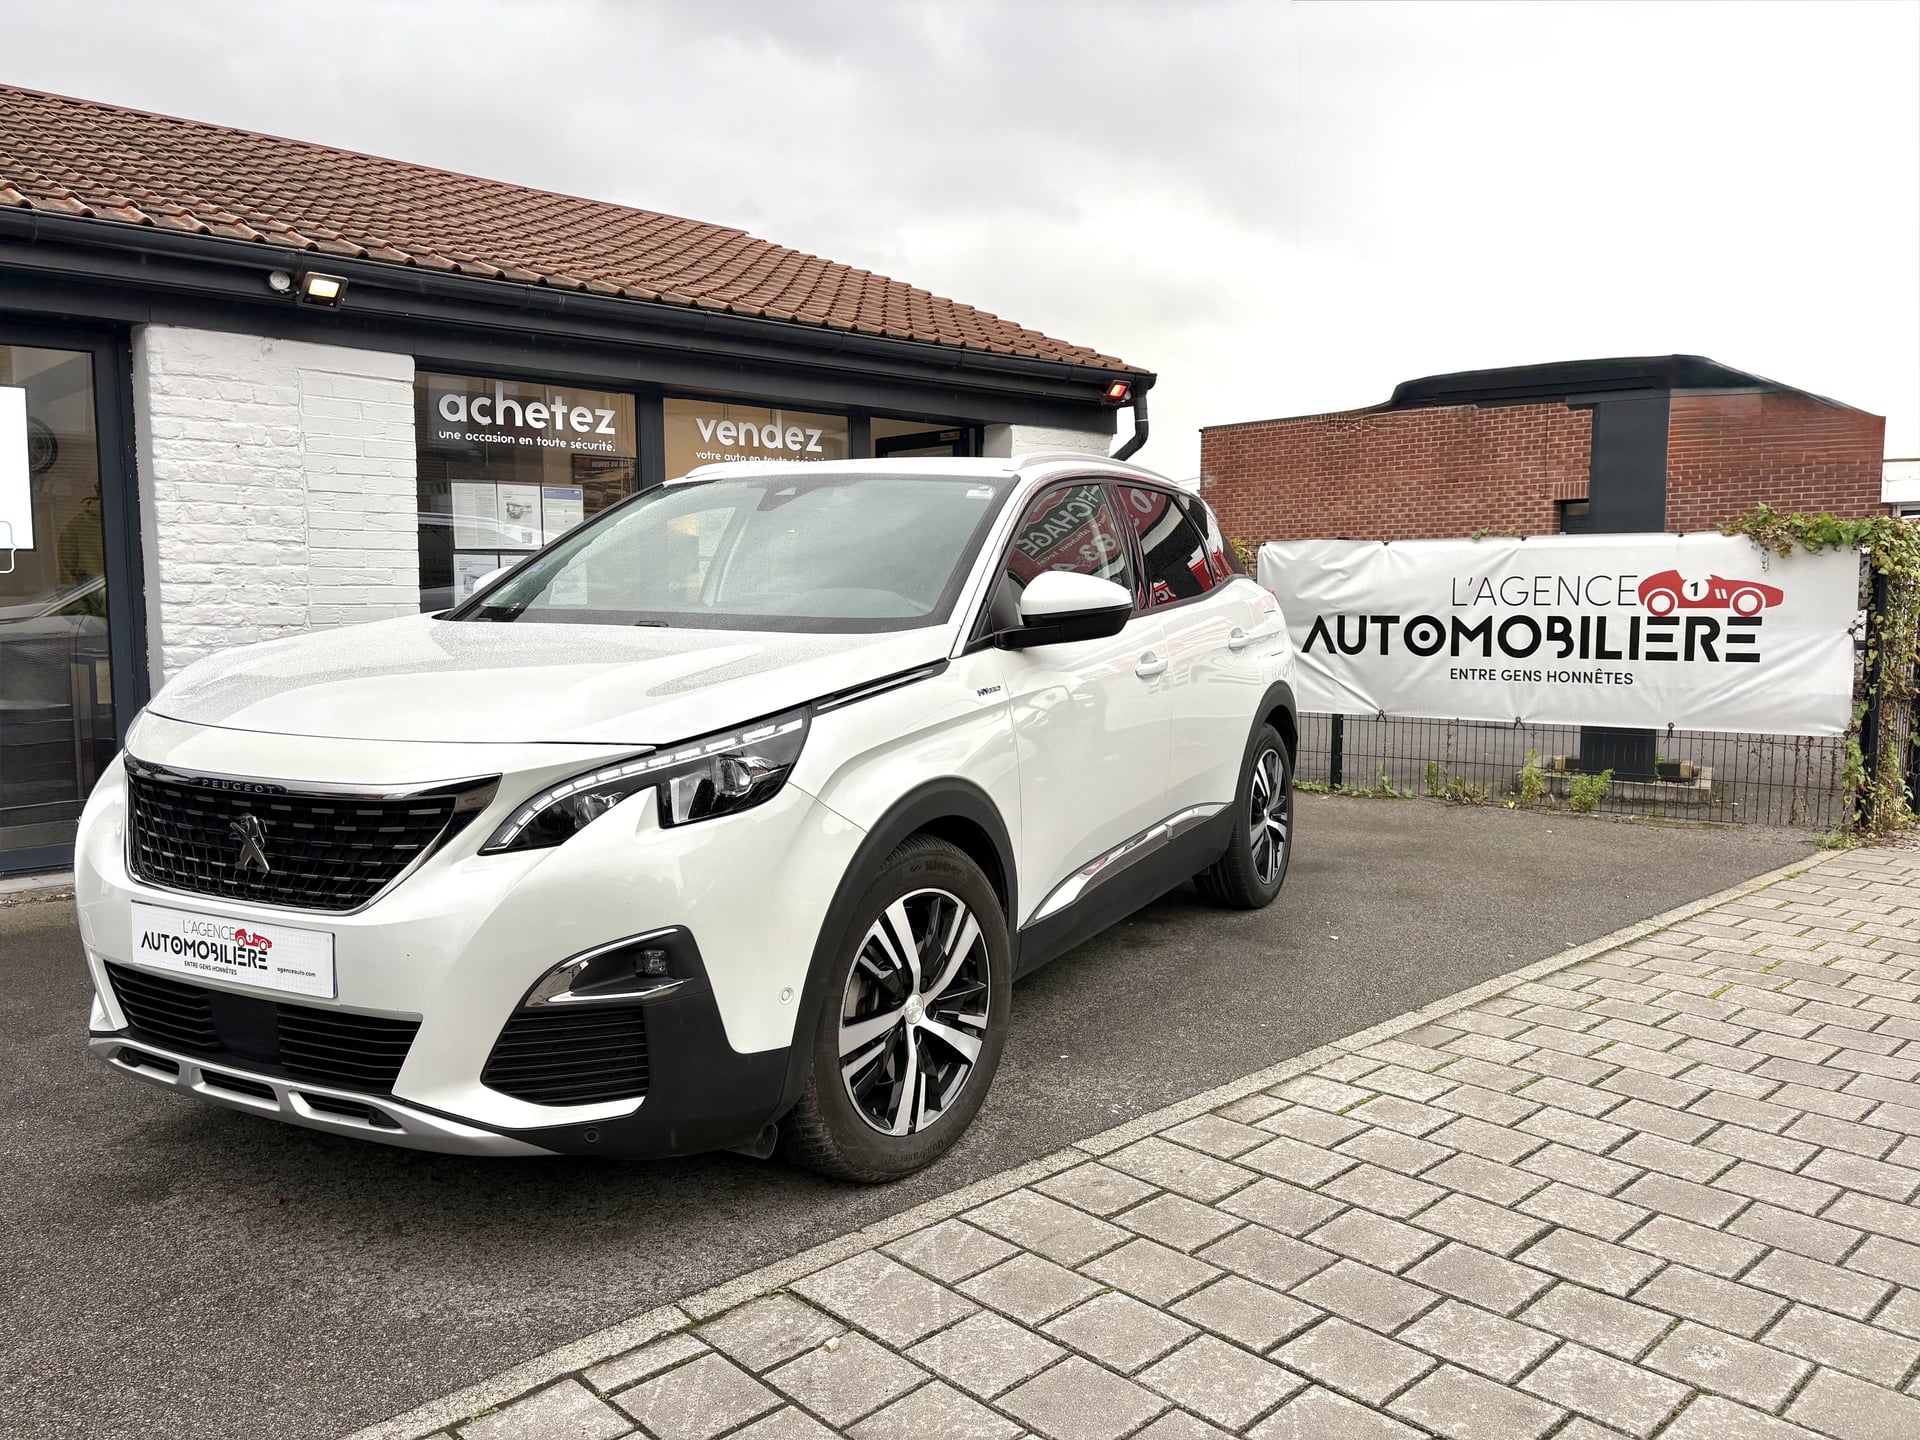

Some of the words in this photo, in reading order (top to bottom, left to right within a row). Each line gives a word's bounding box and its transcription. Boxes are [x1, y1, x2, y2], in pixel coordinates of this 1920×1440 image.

[439, 379, 616, 435] achetez
[696, 409, 823, 452] vendez
[438, 430, 461, 440] une
[465, 432, 515, 445] occasion
[519, 436, 533, 446] en
[536, 436, 567, 448] toute
[570, 438, 616, 452] sécurité.
[696, 450, 722, 460] votre
[724, 453, 746, 462] auto
[1451, 575, 1638, 607] L'AGENCE
[1449, 667, 1498, 682] ENTRE
[1500, 667, 1543, 683] GENS
[1546, 667, 1635, 686] HONNÊTES
[202, 779, 275, 794] PEUGEOT
[182, 920, 236, 942] L'AGENCE
[184, 960, 199, 969] ENTRE
[199, 963, 212, 972] GENS
[212, 965, 238, 976] HONNÊTES
[277, 967, 317, 978] agenceauto.com
